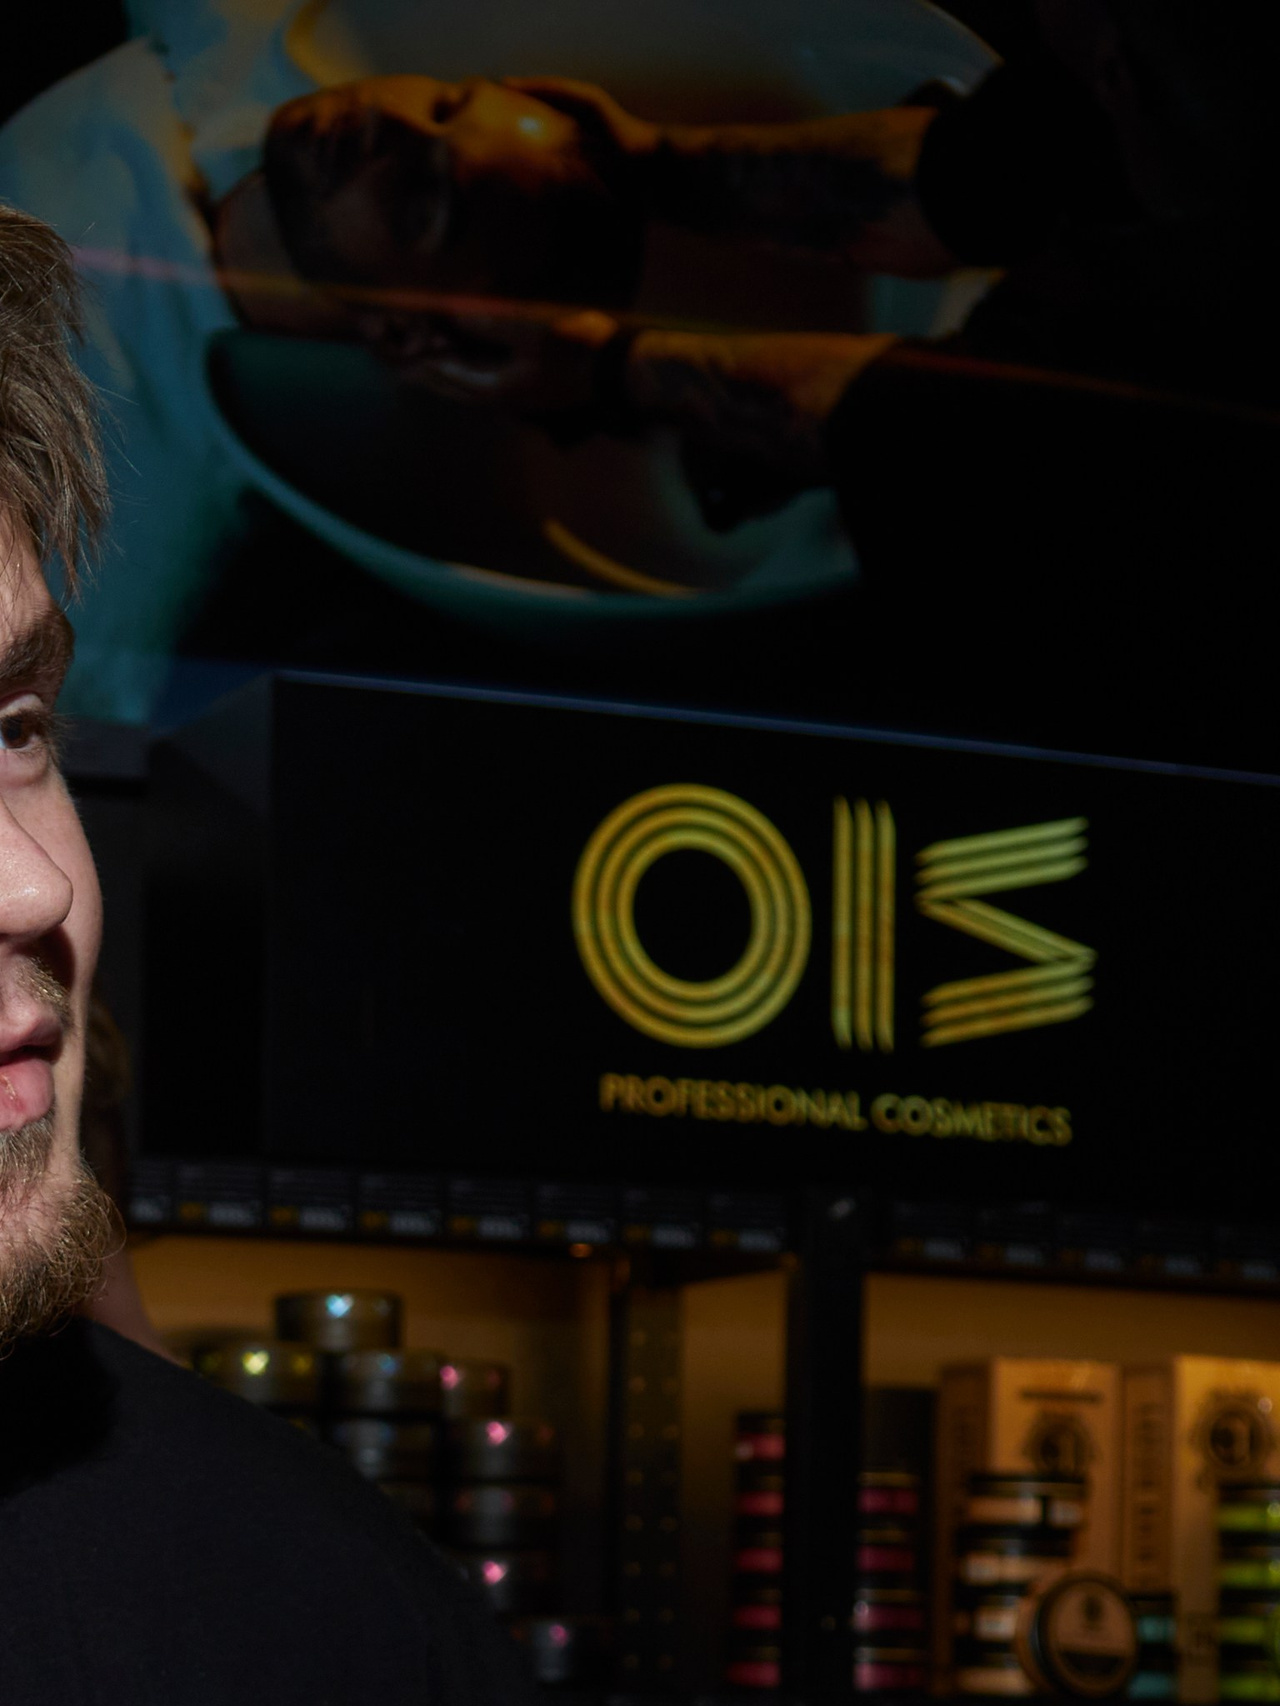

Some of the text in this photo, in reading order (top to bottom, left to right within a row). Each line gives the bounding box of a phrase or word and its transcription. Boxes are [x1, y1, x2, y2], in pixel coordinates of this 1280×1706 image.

[570, 781, 1099, 1054] OIS
[598, 1072, 1073, 1148] PROFESSIONAL COSMETICS
